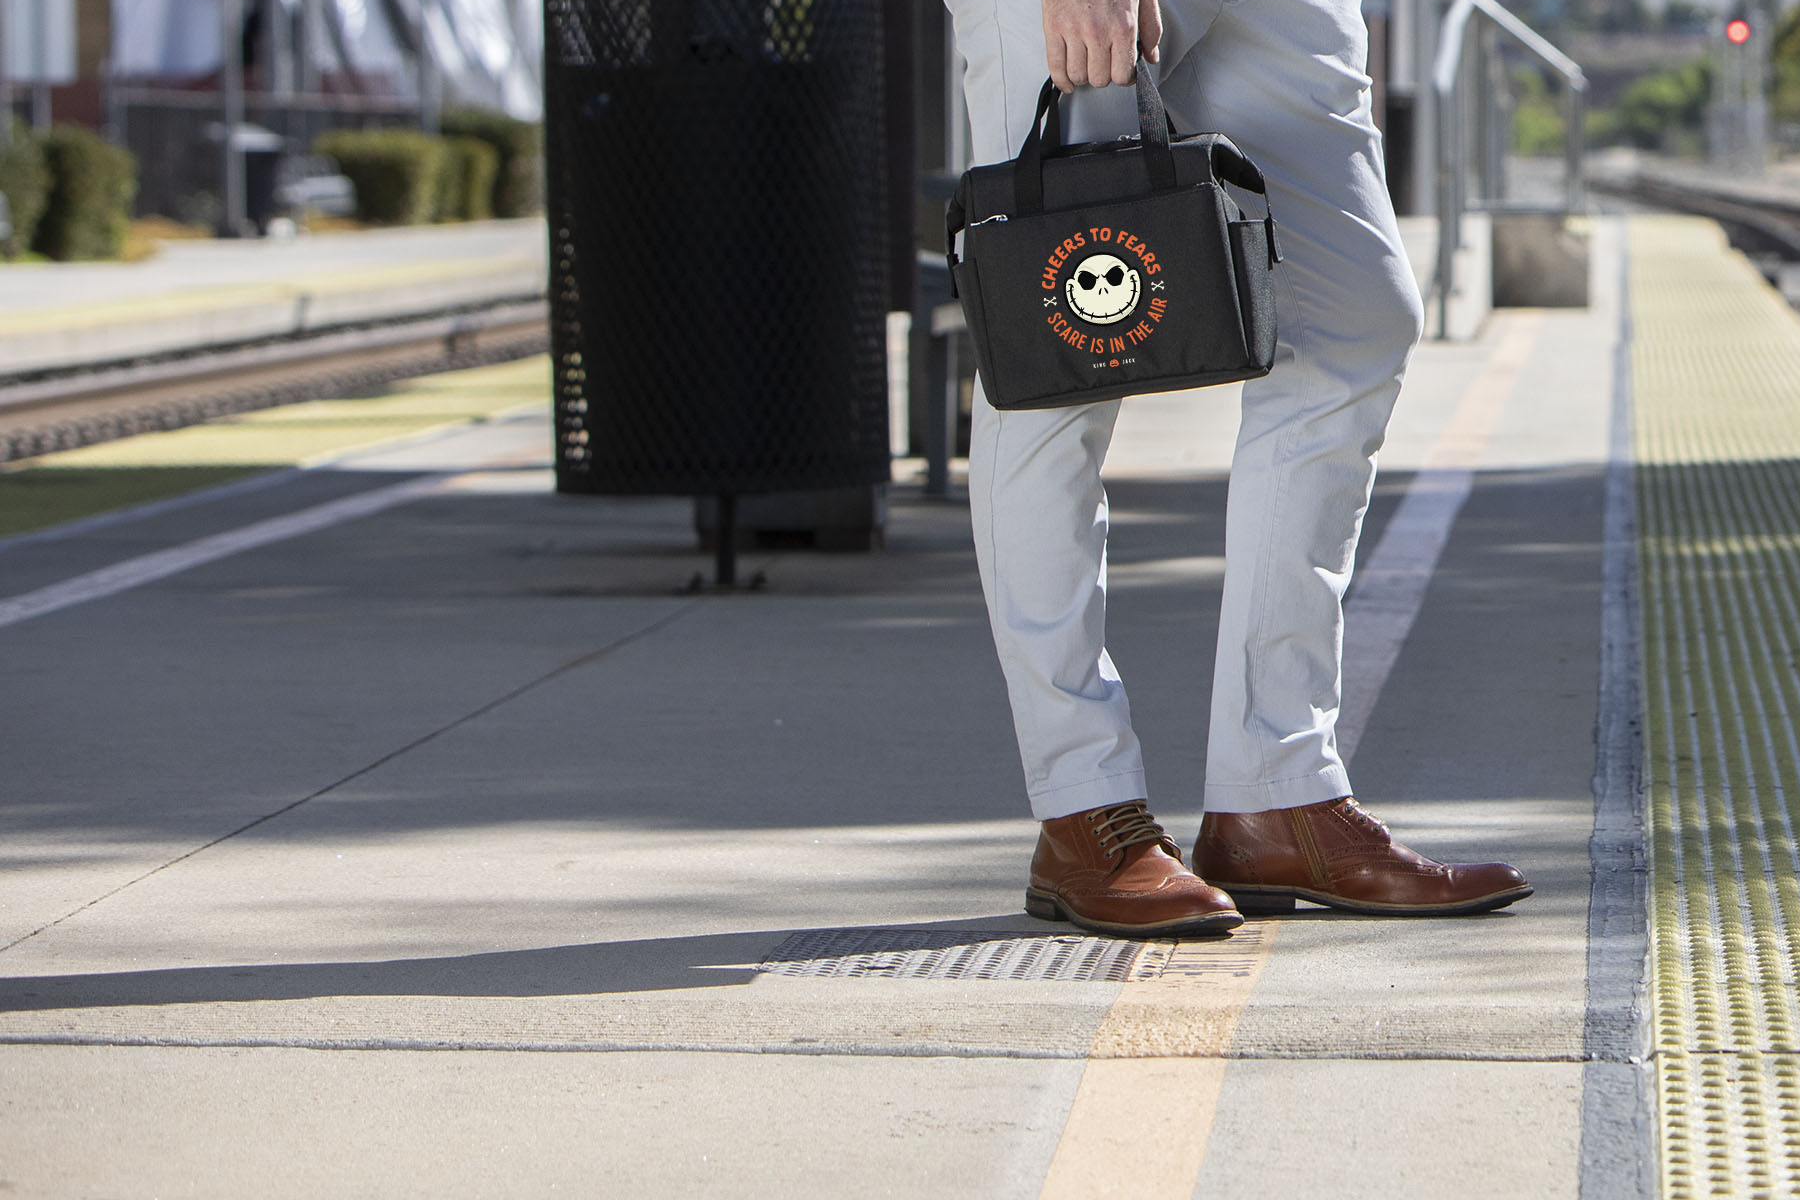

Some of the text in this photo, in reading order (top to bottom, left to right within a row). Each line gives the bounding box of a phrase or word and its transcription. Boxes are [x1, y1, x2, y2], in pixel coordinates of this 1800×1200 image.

[1041, 227, 1162, 290] CHEERS TO FEARS
[1047, 297, 1168, 354] SCARE IS IN THE AIR
